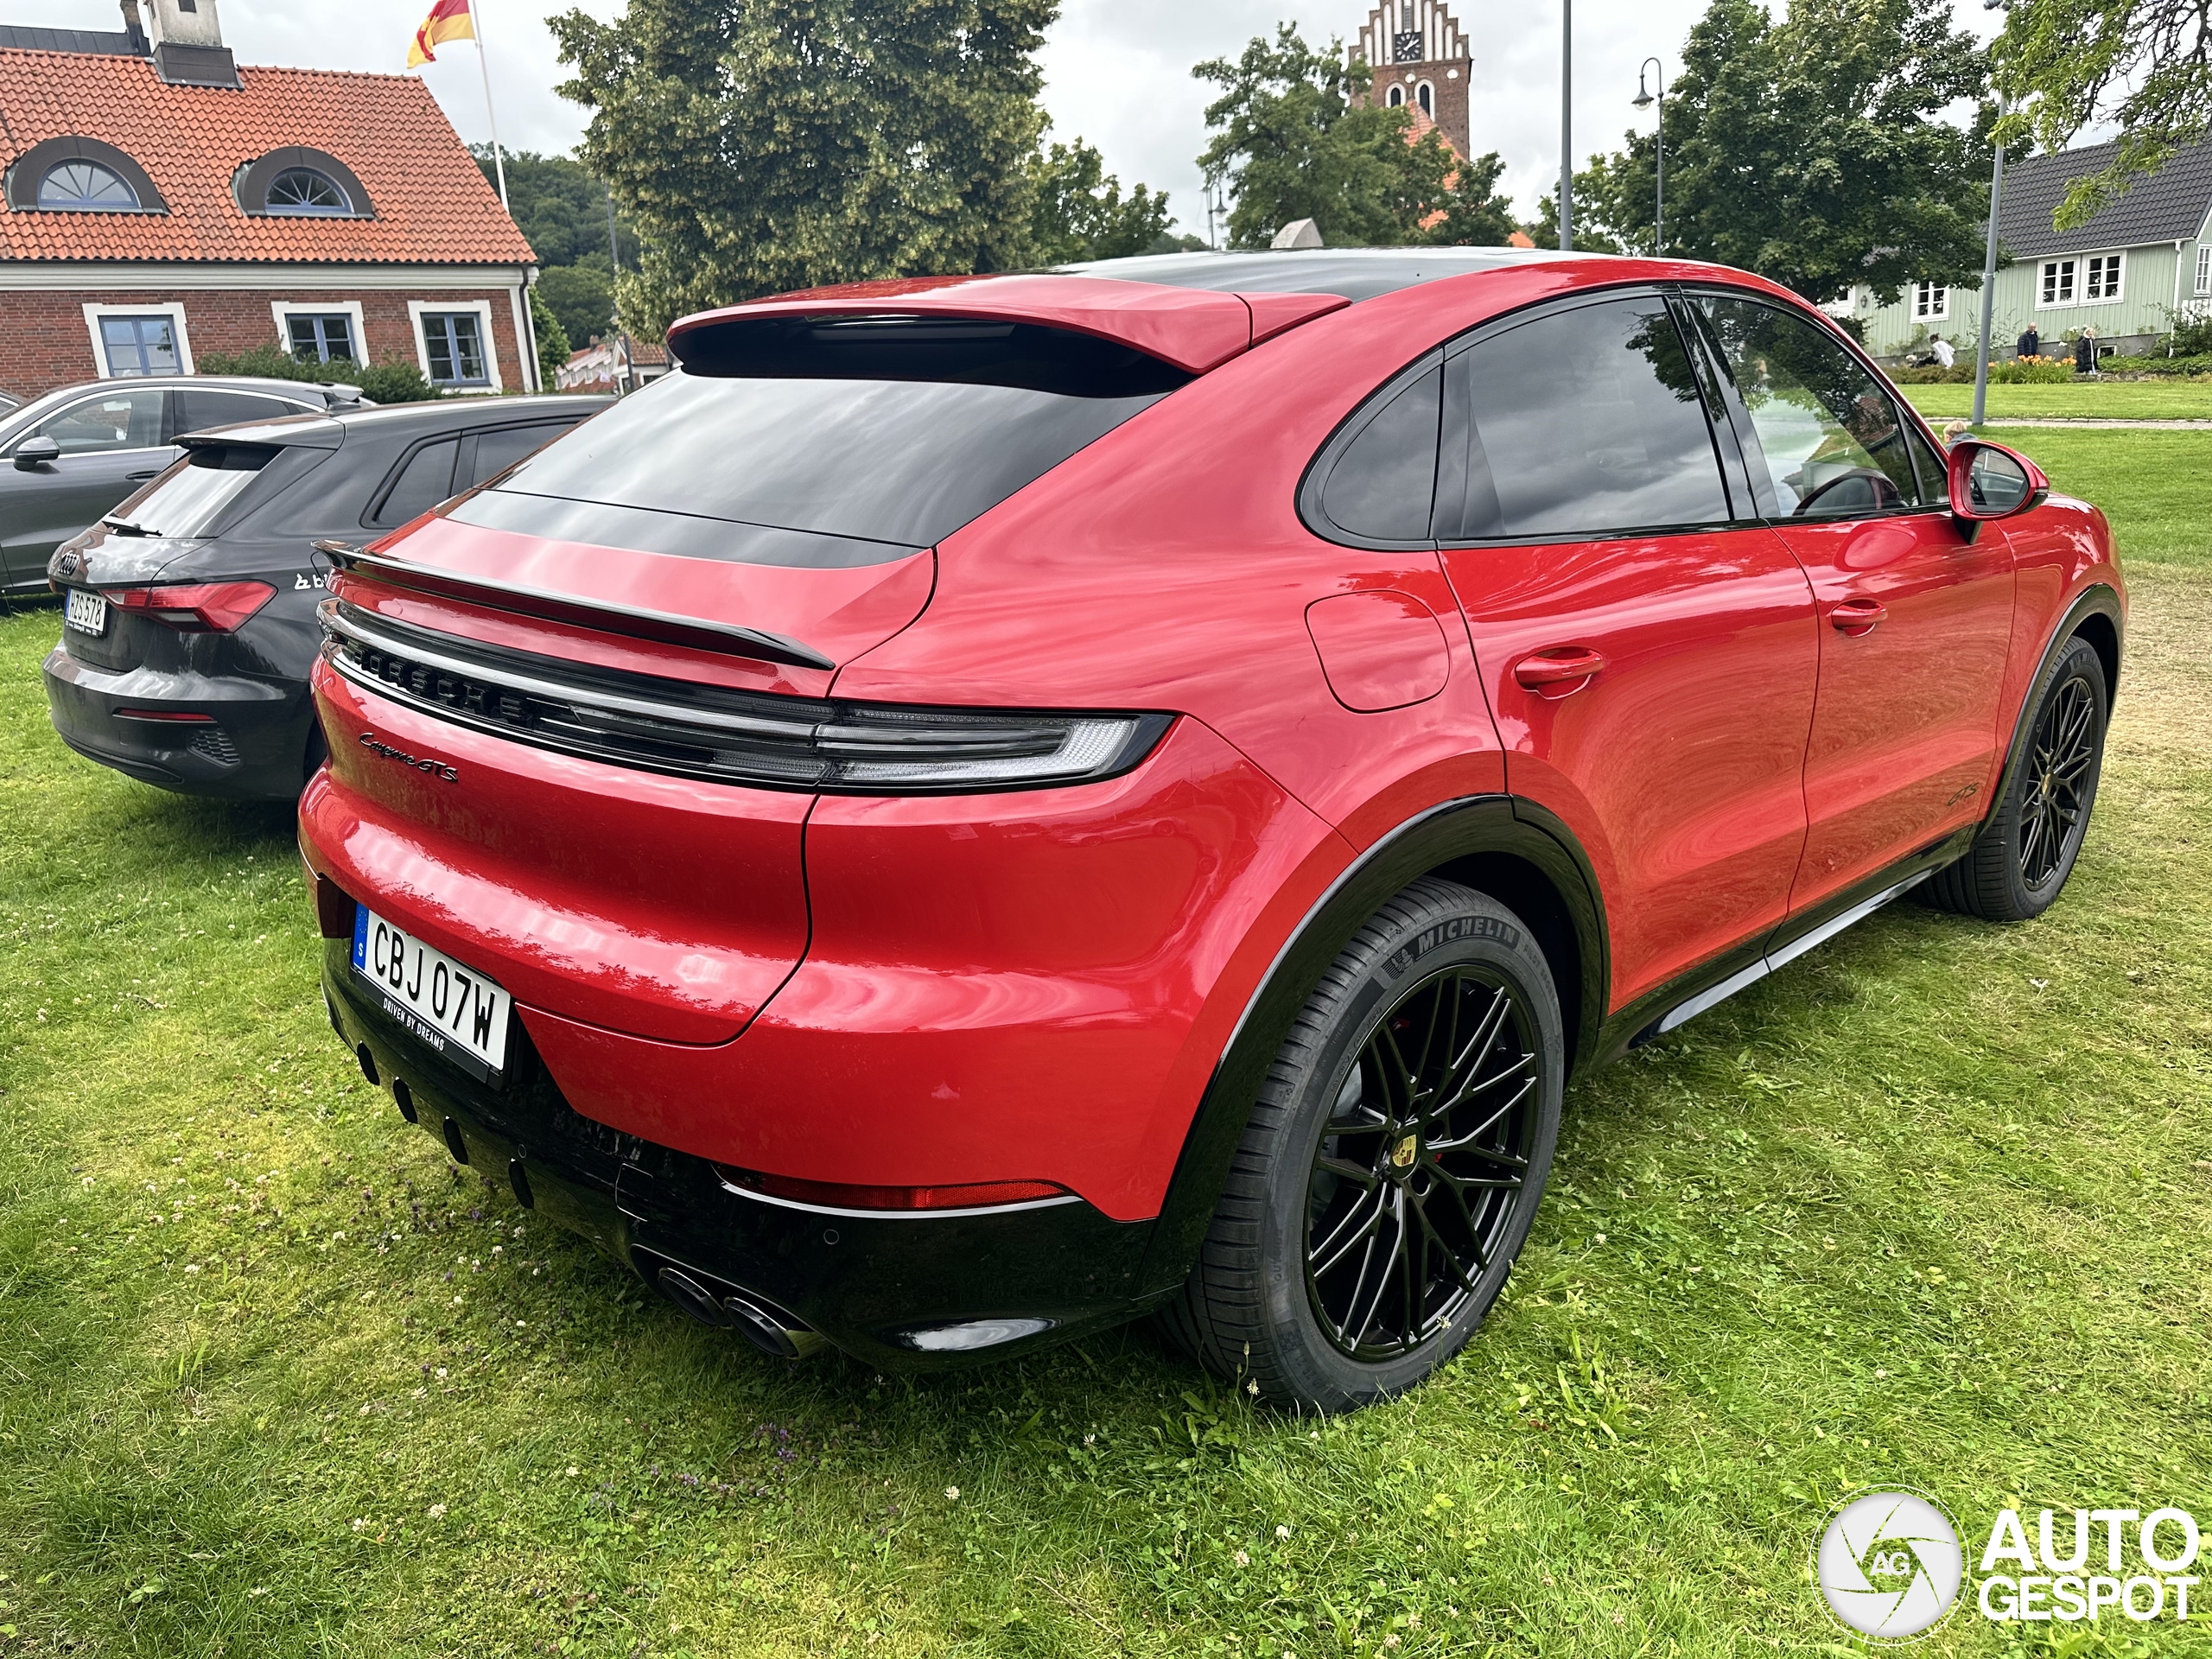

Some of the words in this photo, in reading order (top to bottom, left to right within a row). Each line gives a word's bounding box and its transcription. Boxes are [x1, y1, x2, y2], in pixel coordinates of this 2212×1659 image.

[69, 592, 85, 620] HZS
[85, 596, 102, 626] 578
[359, 732, 416, 766] Cayenne
[416, 759, 458, 783] GTS
[1947, 782, 1980, 806] GTS
[358, 942, 364, 957] S
[1418, 918, 1516, 956] MICHELIN
[374, 921, 423, 1001] CBJ
[432, 960, 496, 1052] 07W
[383, 997, 406, 1024] DRIVEN
[406, 1014, 416, 1030] BY
[416, 1020, 445, 1052] DREAMS
